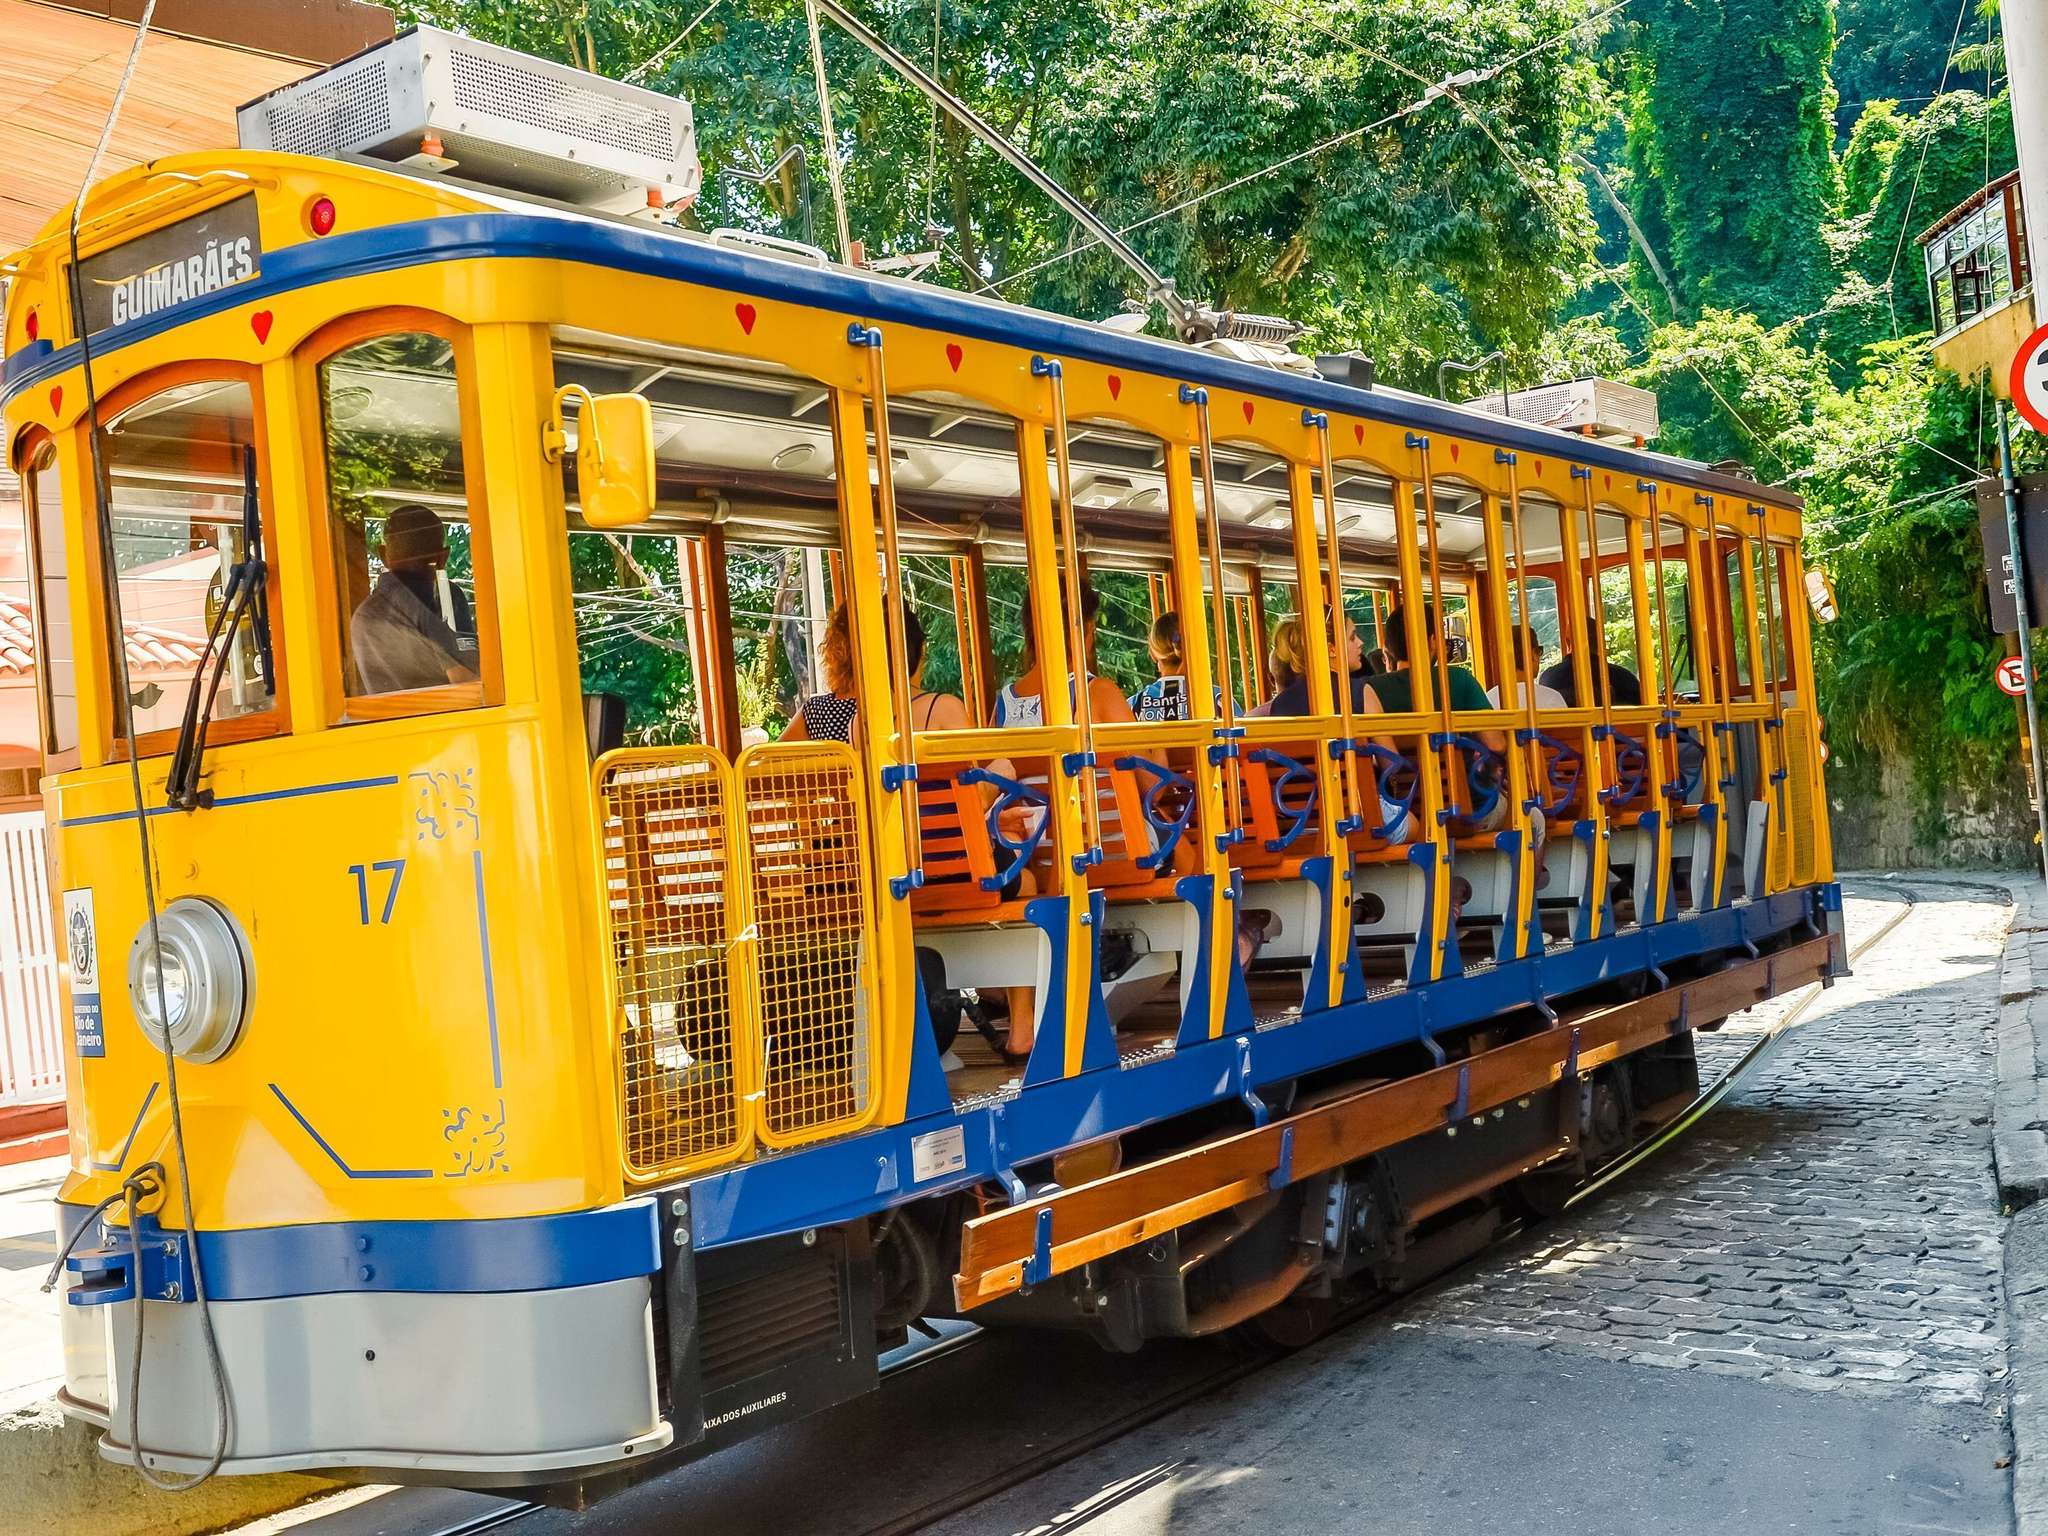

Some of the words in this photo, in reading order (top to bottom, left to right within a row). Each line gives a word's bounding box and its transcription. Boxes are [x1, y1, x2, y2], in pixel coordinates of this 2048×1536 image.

[112, 236, 253, 326] GUIMARÃES
[1142, 693, 1188, 708] Banris
[348, 859, 406, 925] 17
[74, 1015, 85, 1030] Rio
[85, 1016, 95, 1030] de
[76, 1031, 102, 1047] Janeiro
[703, 1416, 722, 1430] AIXA
[722, 1409, 741, 1423] DOS
[741, 1391, 787, 1416] AUXILIARES
